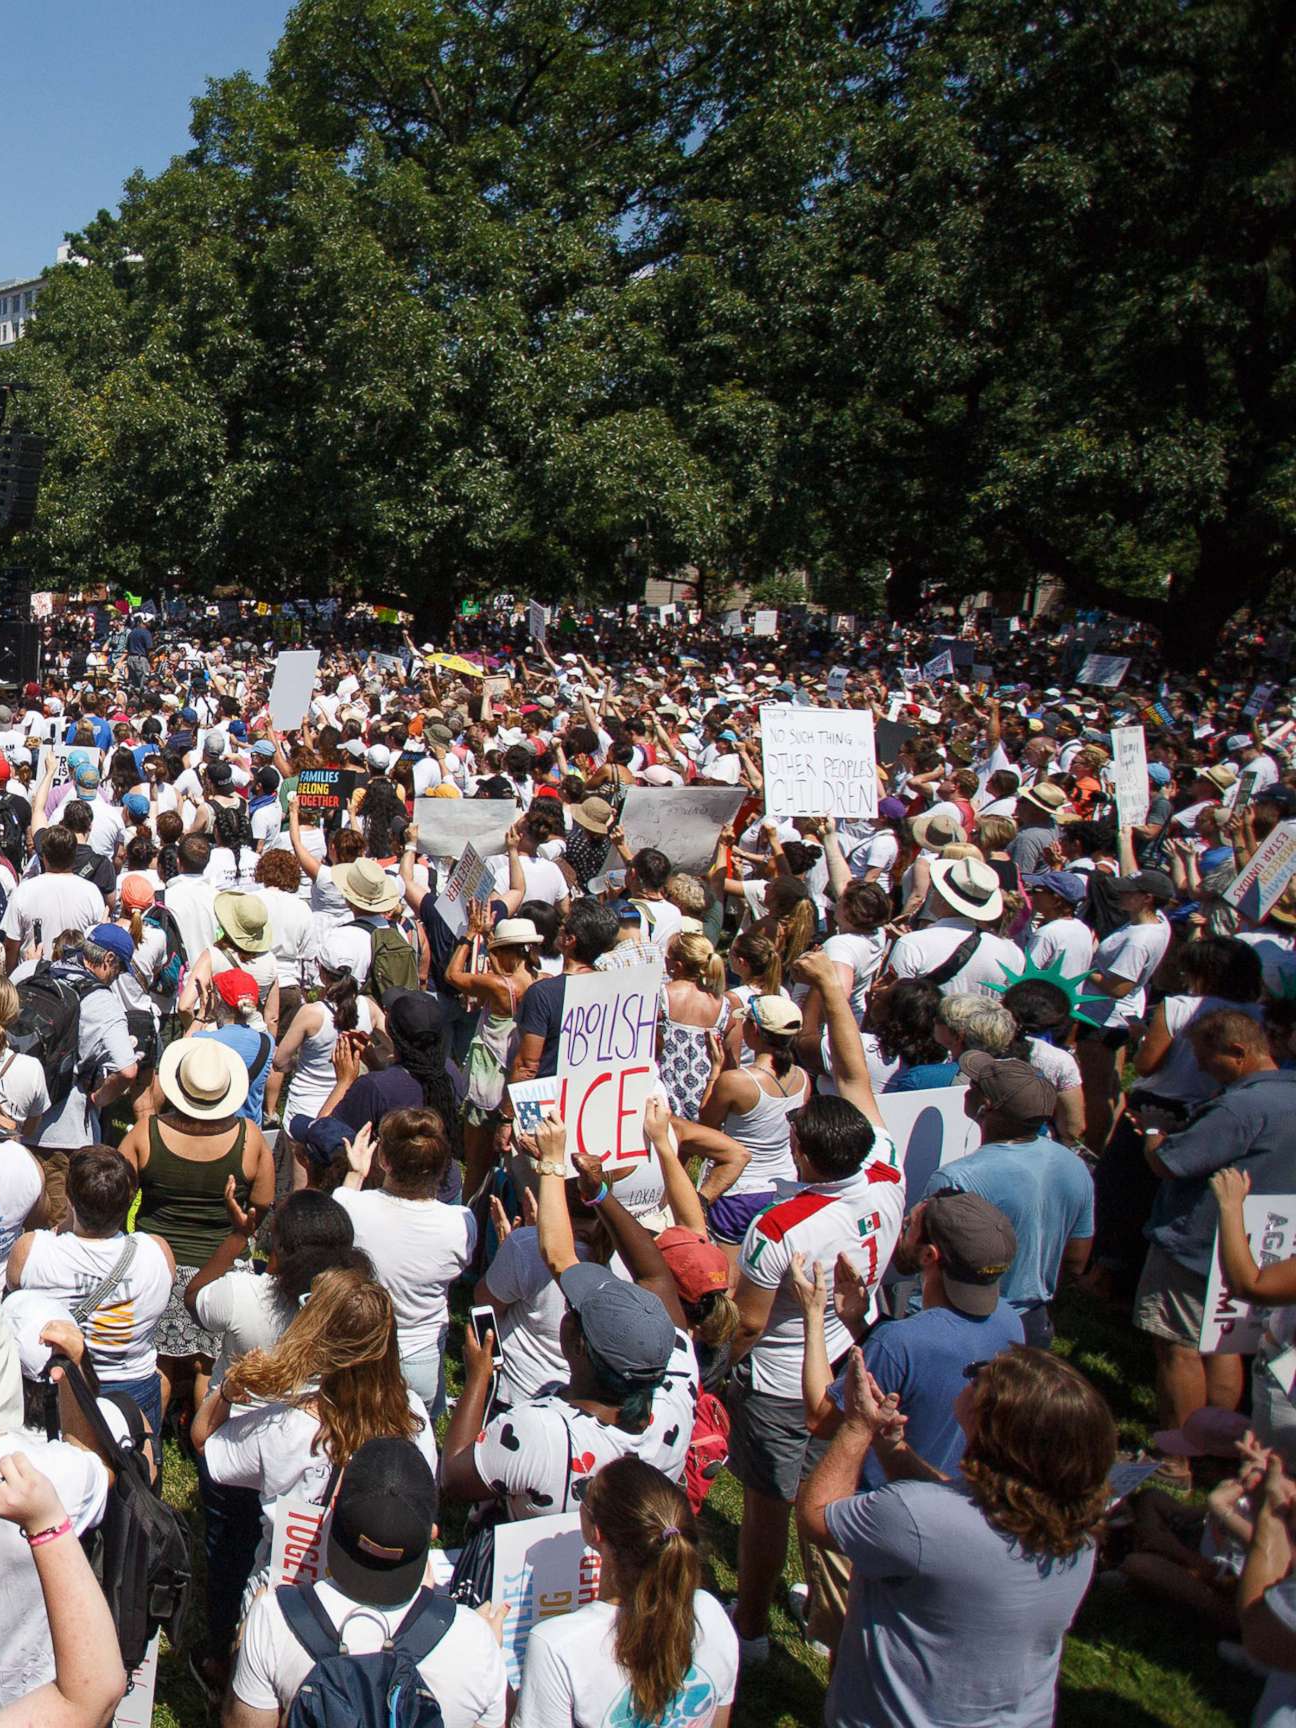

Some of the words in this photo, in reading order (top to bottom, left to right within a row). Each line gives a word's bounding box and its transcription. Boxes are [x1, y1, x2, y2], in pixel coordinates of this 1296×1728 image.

[769, 728, 785, 744] NO
[817, 730, 853, 745] THING
[300, 771, 340, 783] FAMILIES
[767, 752, 816, 777] OTHER
[296, 794, 340, 808] TOGETHER
[297, 783, 330, 795] BELONG
[771, 778, 873, 814] CHILDREN
[1261, 831, 1289, 862] ESTAR
[446, 849, 477, 903] TOGETHER
[1234, 862, 1265, 899] UNIDAS
[560, 993, 659, 1067] ABOLISH
[560, 1067, 651, 1163] ICE
[861, 1235, 879, 1287] 1
[281, 1511, 324, 1585] TOGET
[503, 1568, 534, 1685] AMILIES
